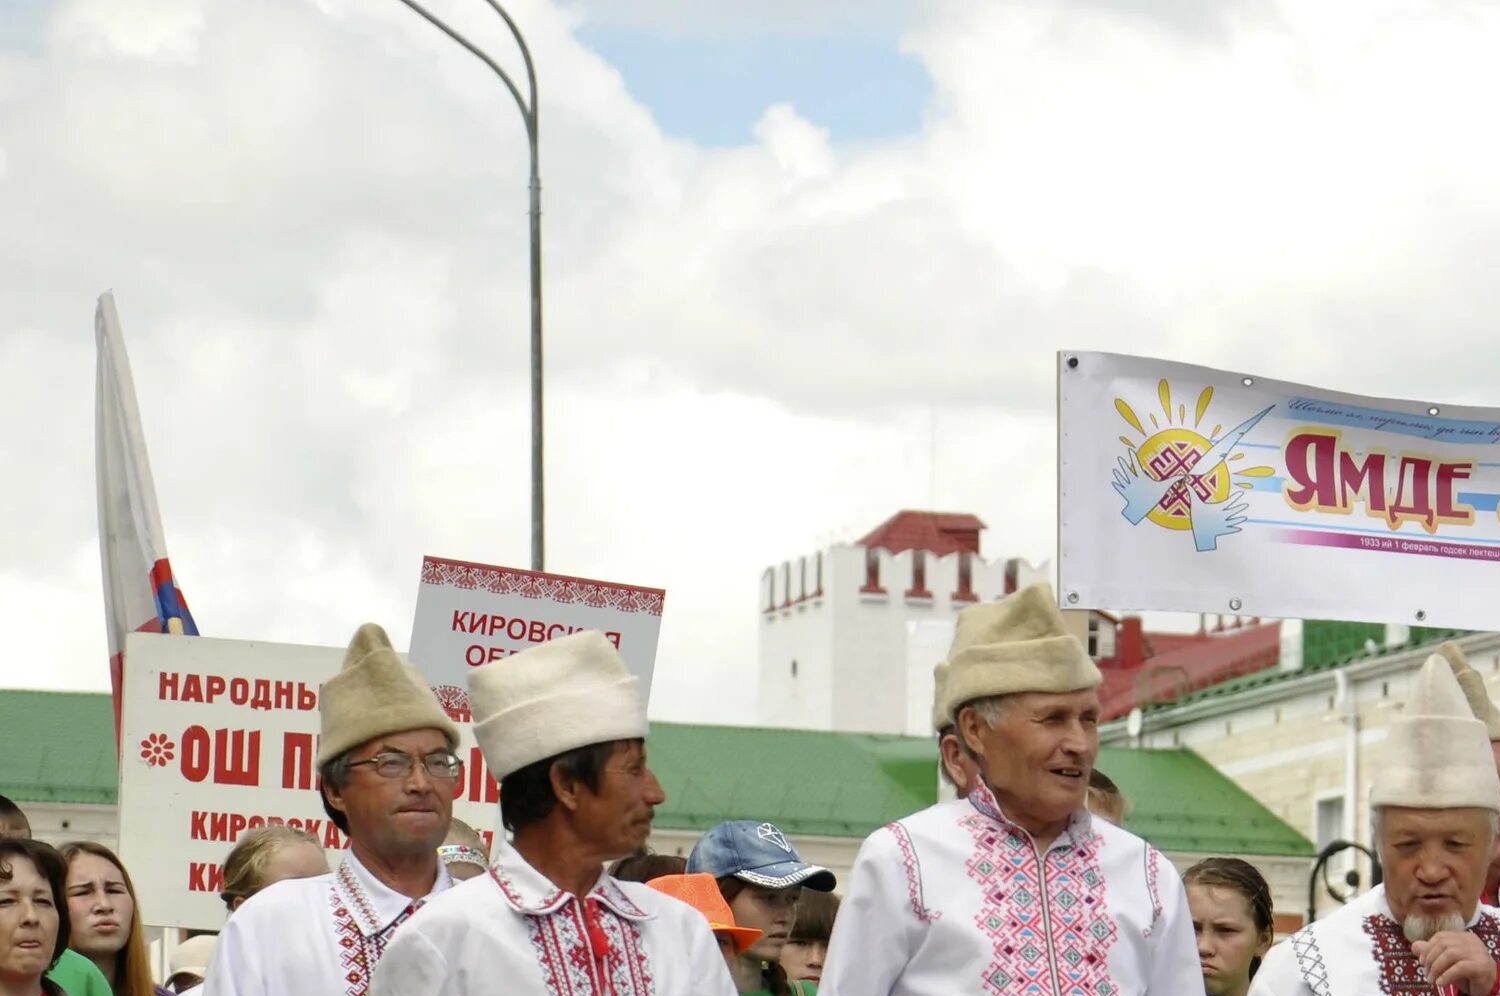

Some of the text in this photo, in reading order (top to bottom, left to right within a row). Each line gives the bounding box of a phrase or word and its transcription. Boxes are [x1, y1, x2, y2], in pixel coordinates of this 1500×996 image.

[1360, 537, 1381, 547] 1933
[1382, 540, 1393, 549] ий
[1401, 542, 1439, 553] февраль
[1440, 545, 1468, 556] годсек
[452, 610, 621, 650] КИРОВСЯ
[159, 672, 322, 712] НАРОДНЫ
[181, 725, 260, 787] ОШ
